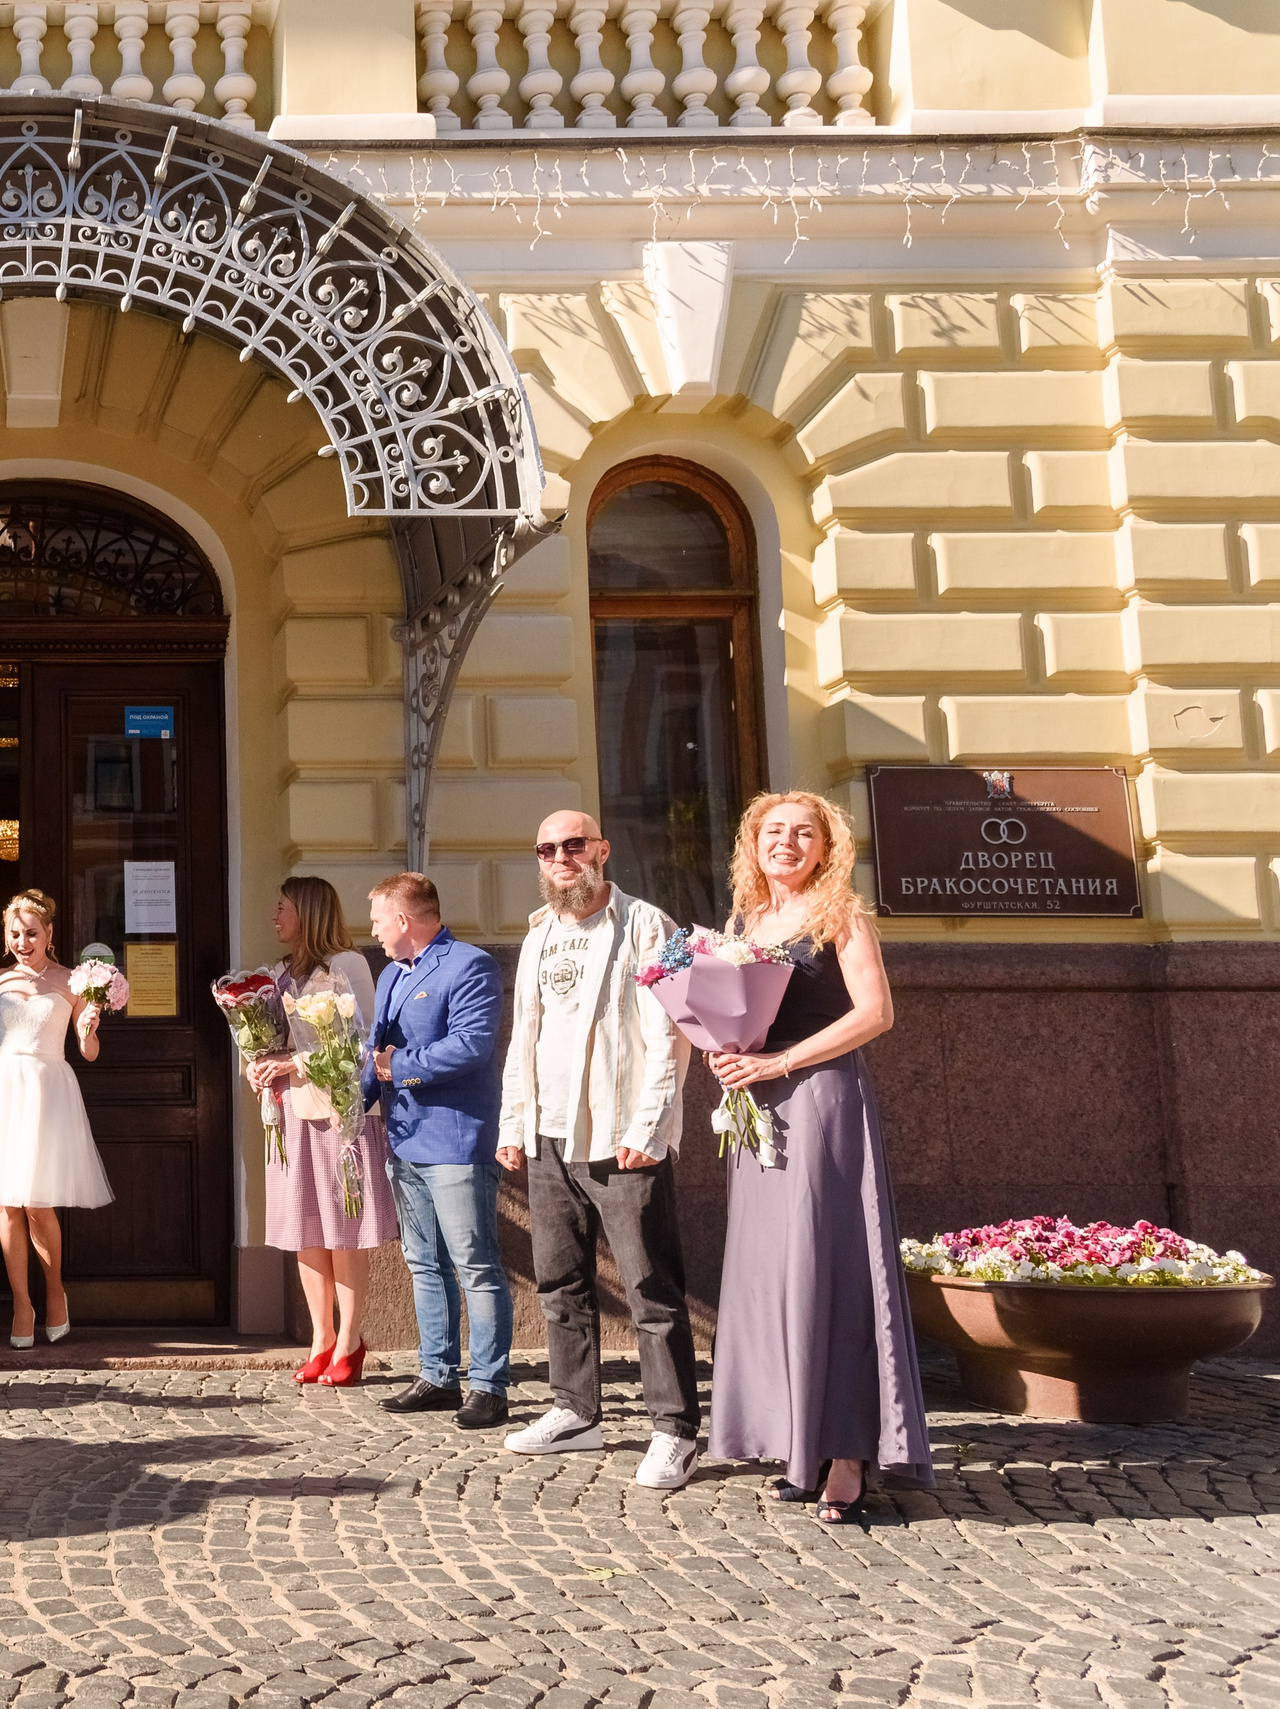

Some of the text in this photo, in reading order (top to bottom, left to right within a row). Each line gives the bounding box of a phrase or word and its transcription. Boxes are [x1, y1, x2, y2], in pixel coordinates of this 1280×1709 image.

[959, 852, 1056, 870] ДВОРЕЦ
[900, 877, 1119, 895] БРАКОСОЧЕТАНИЯ
[1046, 900, 1061, 909] 52
[541, 938, 589, 961] OM TAIL
